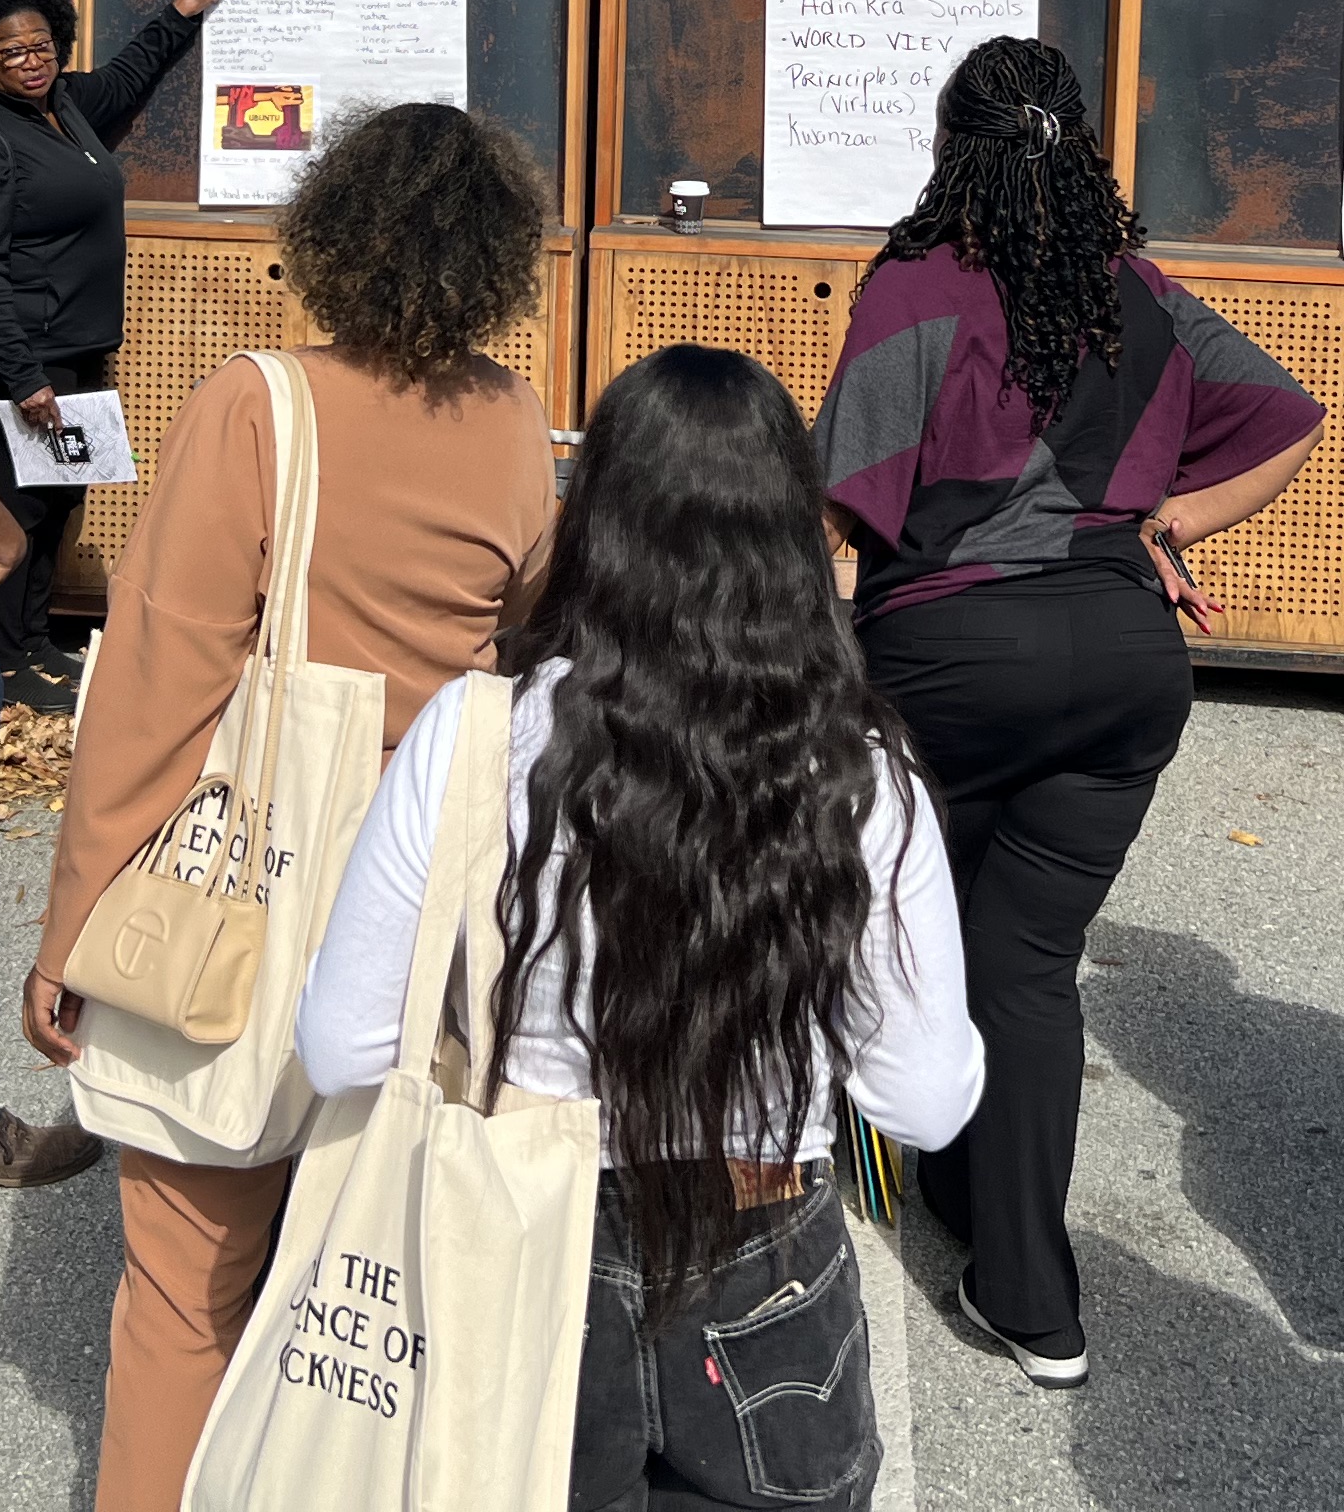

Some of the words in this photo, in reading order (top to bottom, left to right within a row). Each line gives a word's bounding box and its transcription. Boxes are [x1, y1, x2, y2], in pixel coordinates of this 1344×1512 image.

[789, 27, 867, 50] WORLD
[787, 113, 878, 147] Kwanzaa
[264, 846, 295, 878] OF
[340, 1252, 402, 1306] THE
[383, 1325, 426, 1371] OF
